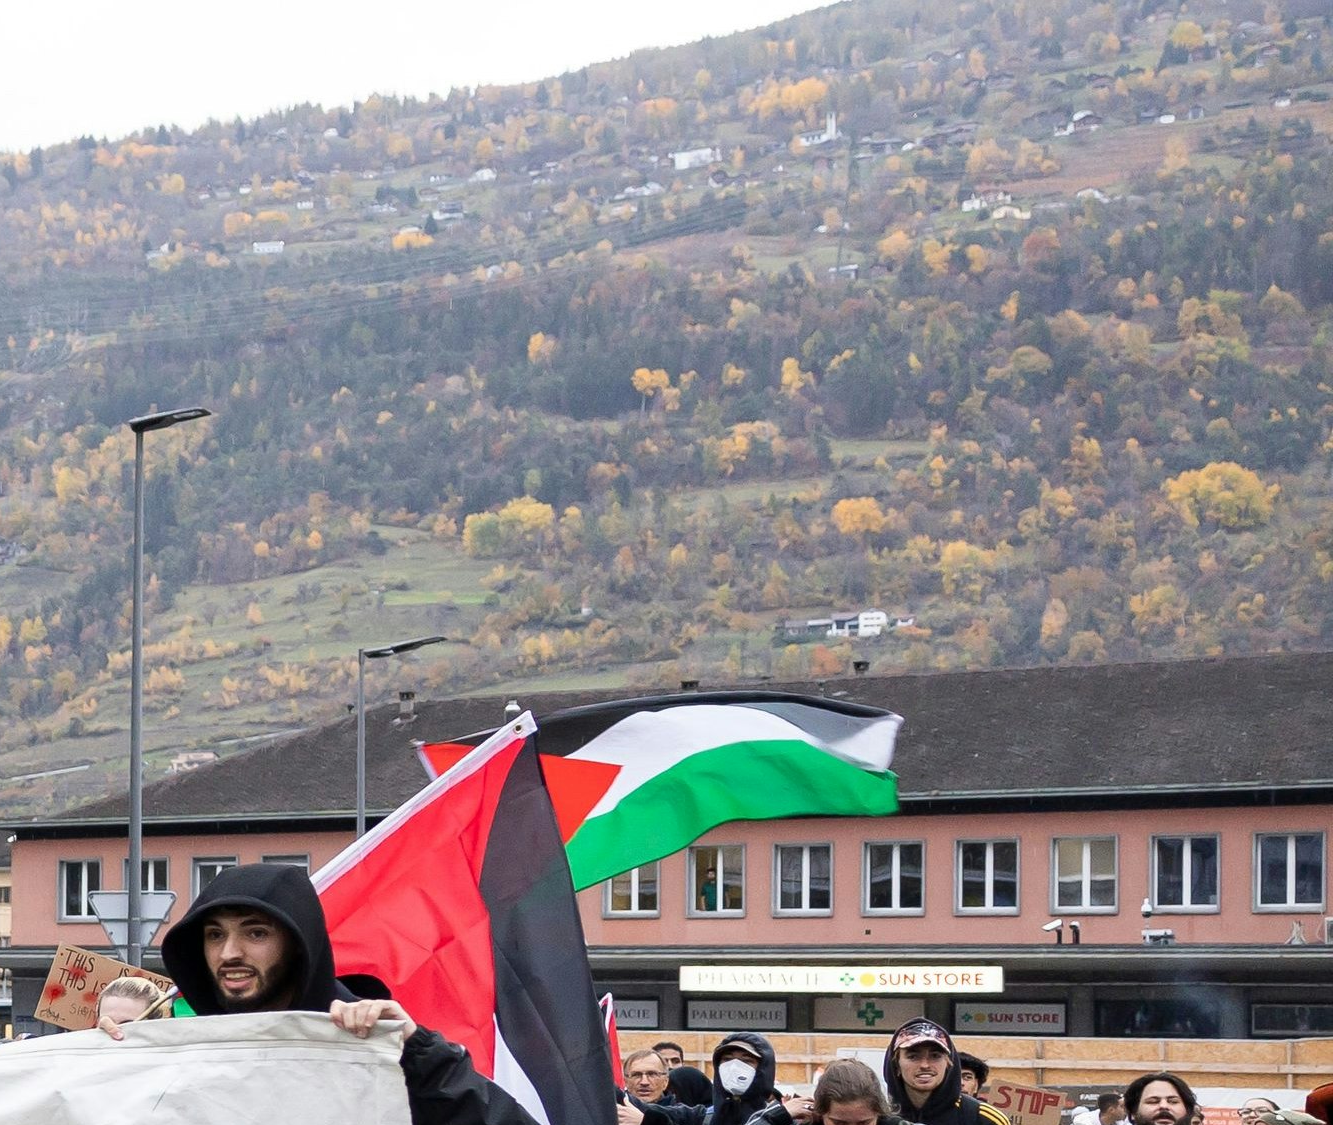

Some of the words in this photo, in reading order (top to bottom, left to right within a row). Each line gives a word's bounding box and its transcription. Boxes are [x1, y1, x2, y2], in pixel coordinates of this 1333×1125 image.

[65, 948, 95, 973] THIS
[59, 967, 87, 991] THIS
[698, 972, 819, 985] PHARMACIE
[879, 973, 916, 986] SUN
[923, 973, 984, 986] STORE
[691, 1008, 783, 1021] PARFUMERIE
[987, 1012, 1013, 1023] SUN
[1017, 1012, 1060, 1023] STORE
[992, 1085, 1061, 1115] STOP
